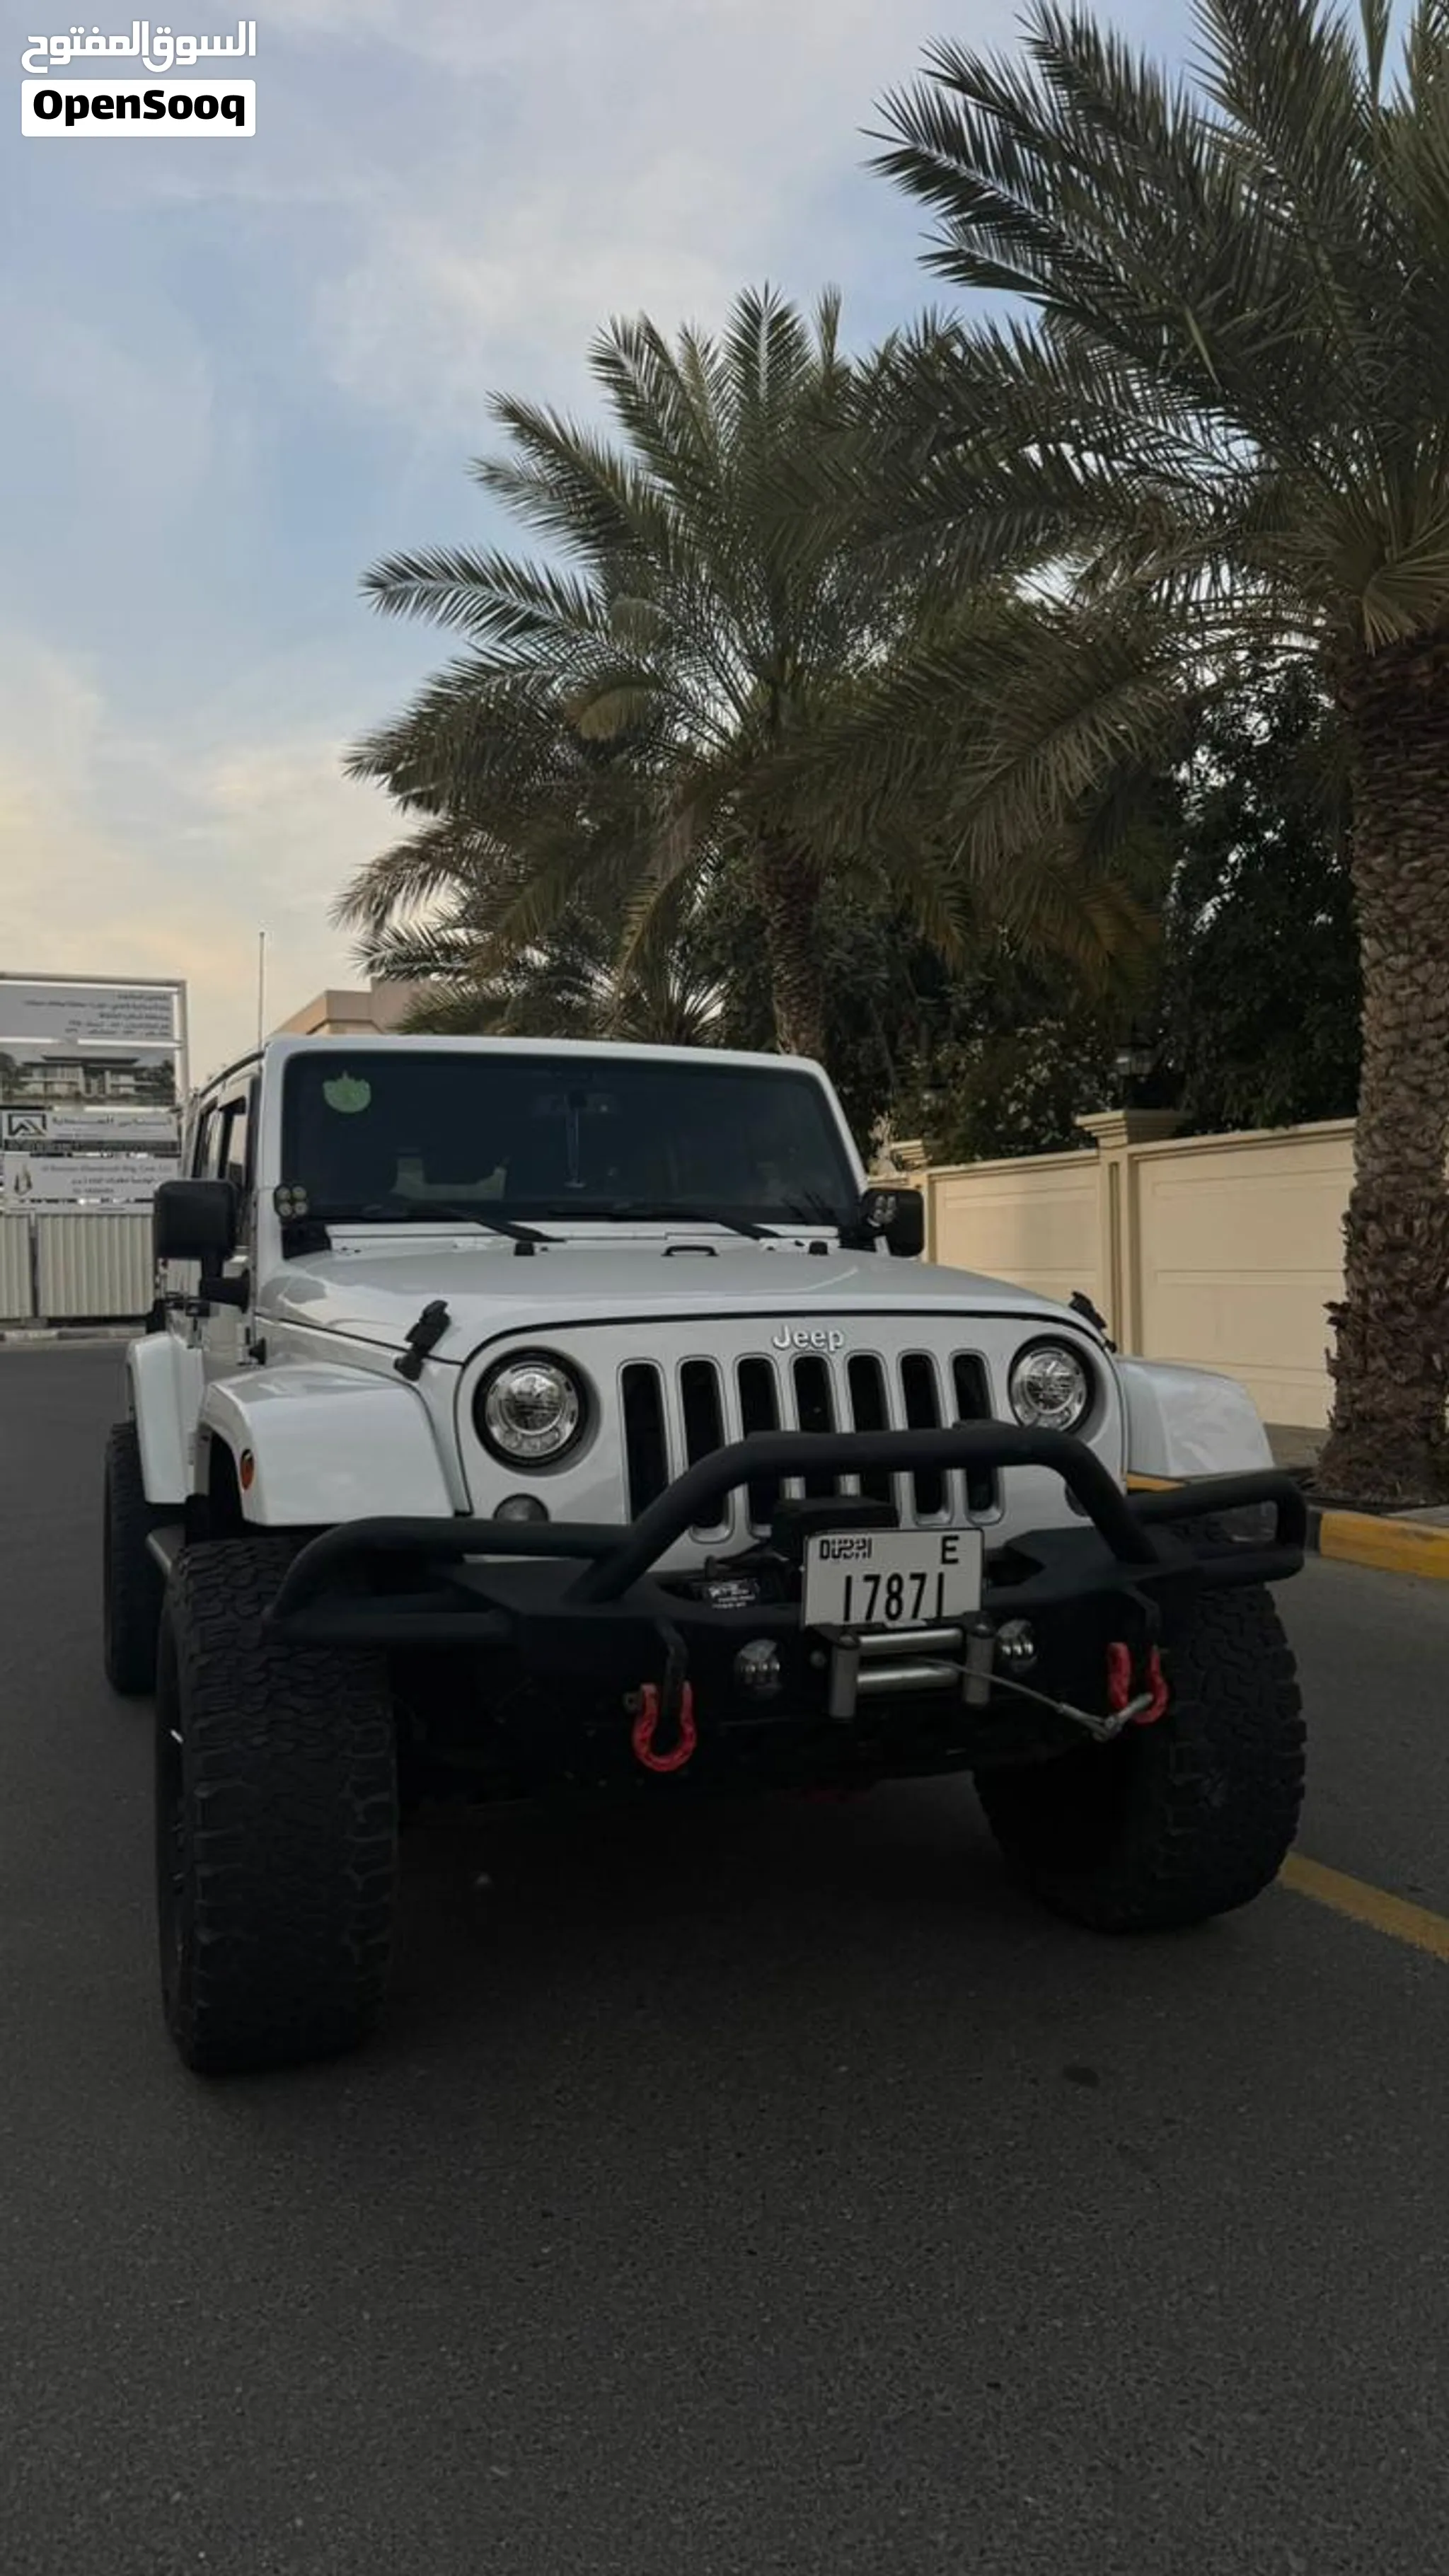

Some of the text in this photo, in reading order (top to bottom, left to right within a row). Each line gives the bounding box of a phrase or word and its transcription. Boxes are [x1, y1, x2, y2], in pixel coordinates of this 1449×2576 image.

[773, 1324, 845, 1353] Jeep
[940, 1535, 959, 1564] E
[843, 1571, 945, 1622] 17871
